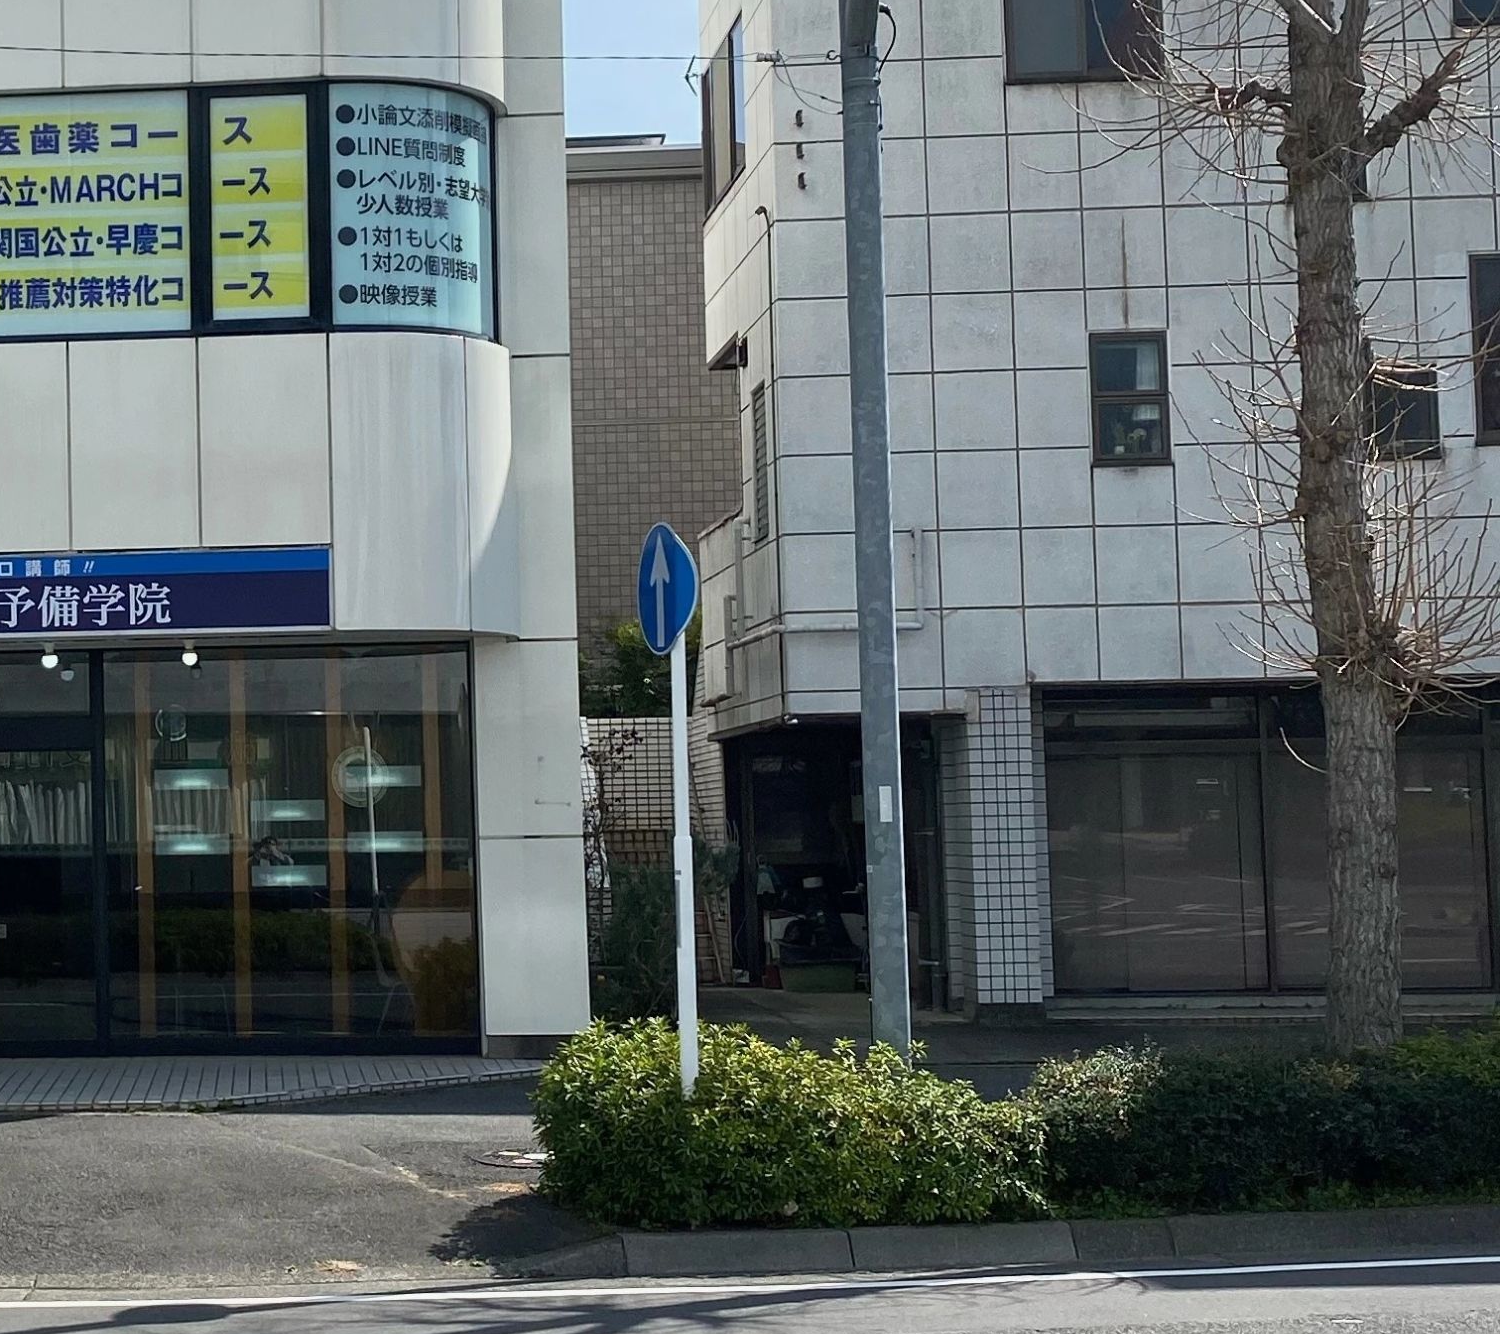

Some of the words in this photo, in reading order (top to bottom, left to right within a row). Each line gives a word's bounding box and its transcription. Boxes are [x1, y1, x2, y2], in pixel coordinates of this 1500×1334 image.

[357, 137, 467, 168] LINE質問制度
[356, 193, 450, 220] 少人数授業
[359, 226, 463, 253] 1対1もしくは
[359, 252, 478, 284] 1対2の個別指導
[359, 284, 438, 308] 映像授業
